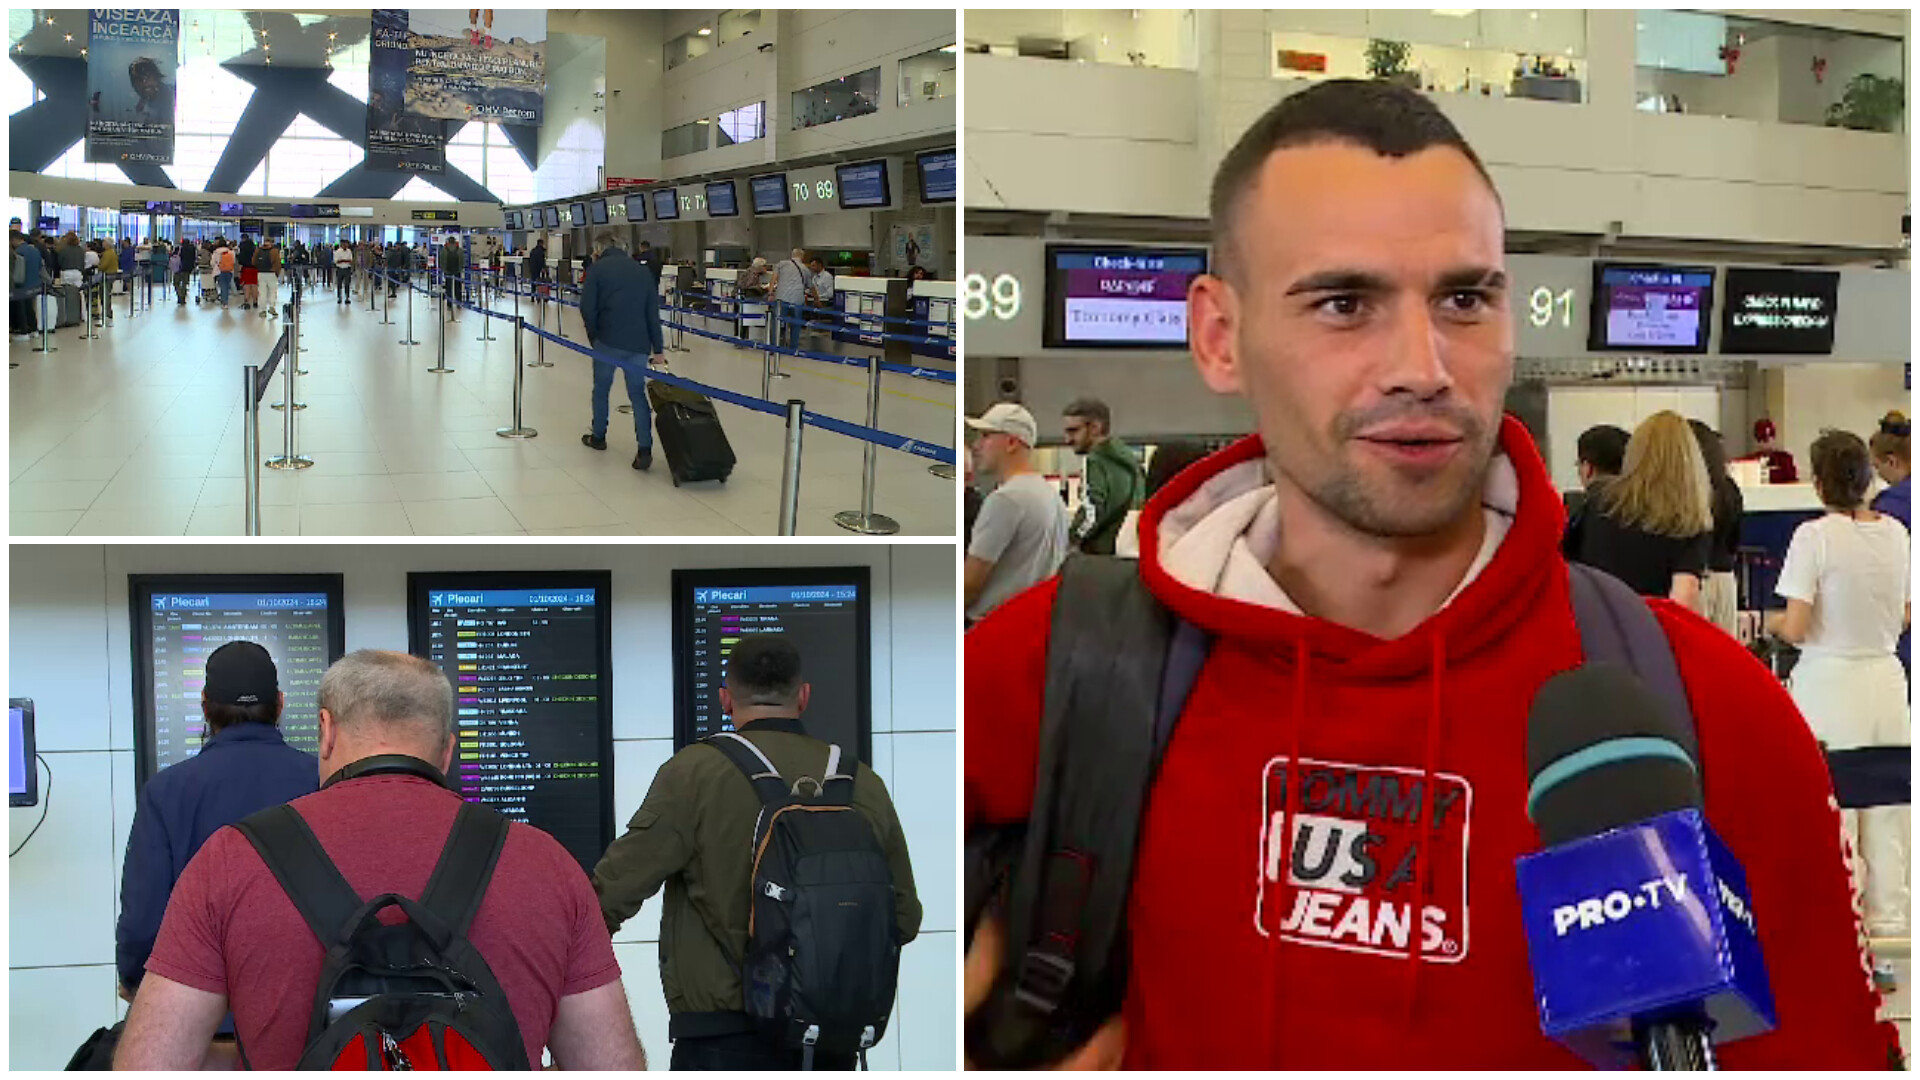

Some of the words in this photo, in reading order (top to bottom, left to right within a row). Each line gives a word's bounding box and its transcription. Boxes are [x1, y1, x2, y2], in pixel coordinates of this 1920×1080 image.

[792, 183, 809, 202] 70
[816, 180, 834, 199] 69
[964, 273, 1022, 321] 89
[1529, 285, 1575, 328] 91
[171, 597, 210, 607] Plecari
[448, 593, 484, 604] Plecari
[711, 590, 747, 600] Plecari
[1274, 769, 1463, 829] TOMMY
[1280, 890, 1447, 951] JEANS
